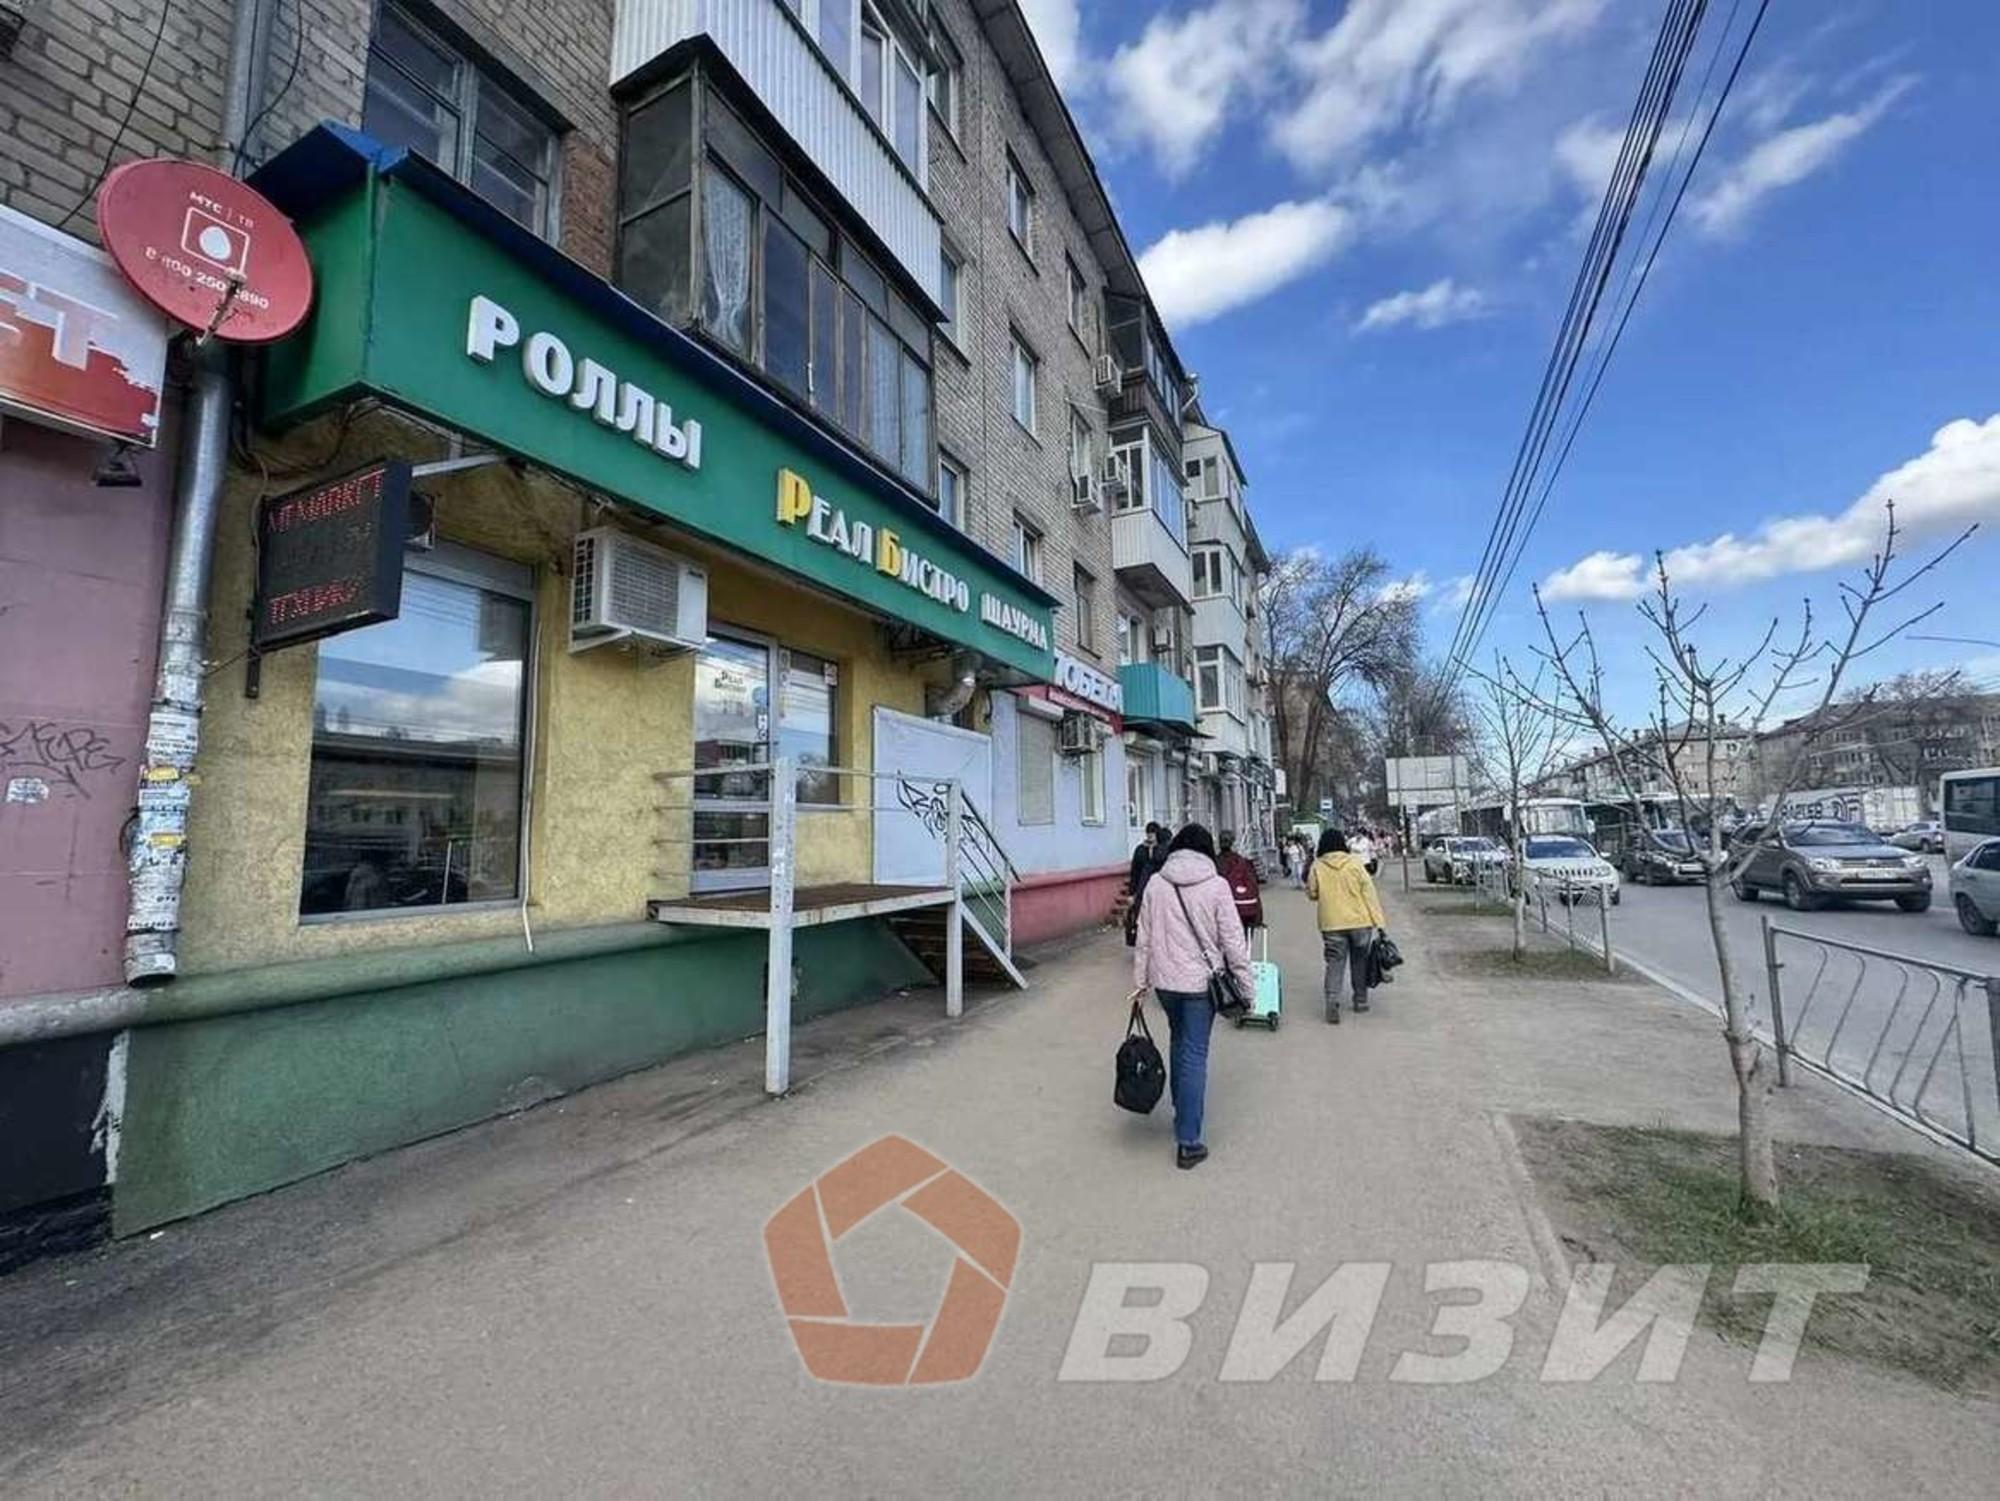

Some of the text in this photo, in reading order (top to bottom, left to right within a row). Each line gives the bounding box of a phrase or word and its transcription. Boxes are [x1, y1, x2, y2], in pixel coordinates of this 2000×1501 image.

[196, 271, 227, 293] 250
[467, 295, 701, 470] РОЛЛЫ
[776, 467, 970, 613] РЕАЛ БИСТРО
